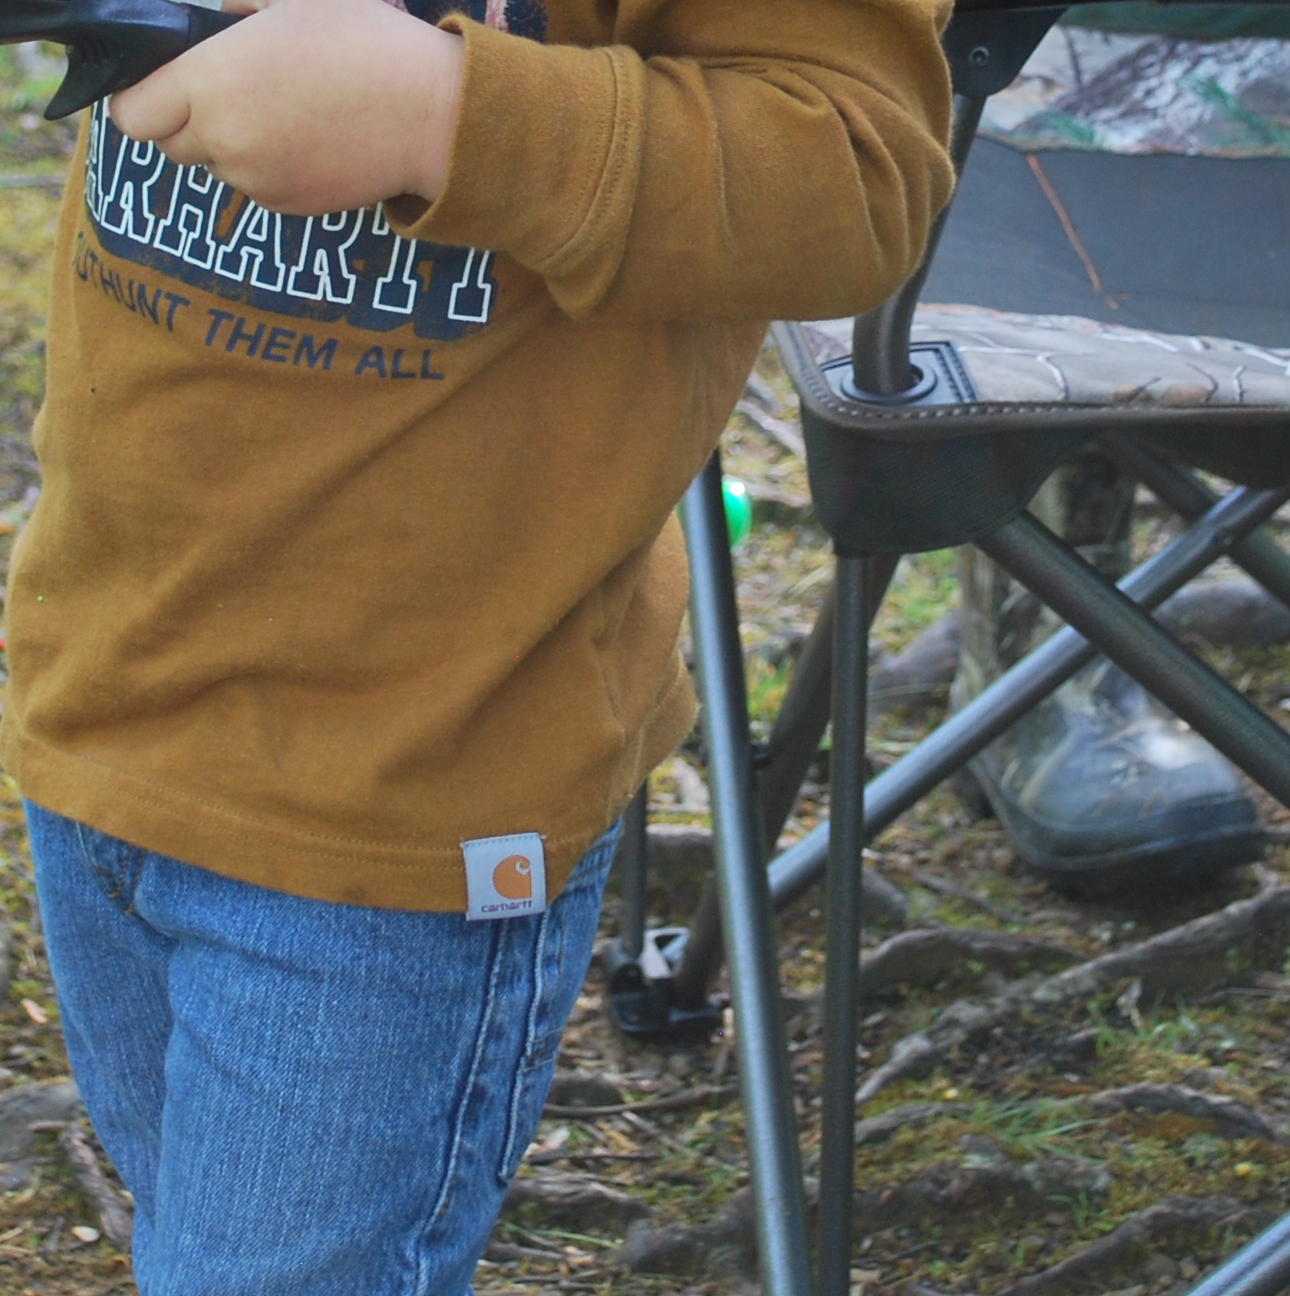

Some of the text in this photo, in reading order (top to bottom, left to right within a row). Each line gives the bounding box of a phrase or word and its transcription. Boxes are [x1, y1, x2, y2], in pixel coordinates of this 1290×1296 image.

[205, 308, 340, 372] THEM
[354, 344, 446, 381] ALL
[481, 900, 533, 913] carhartt
